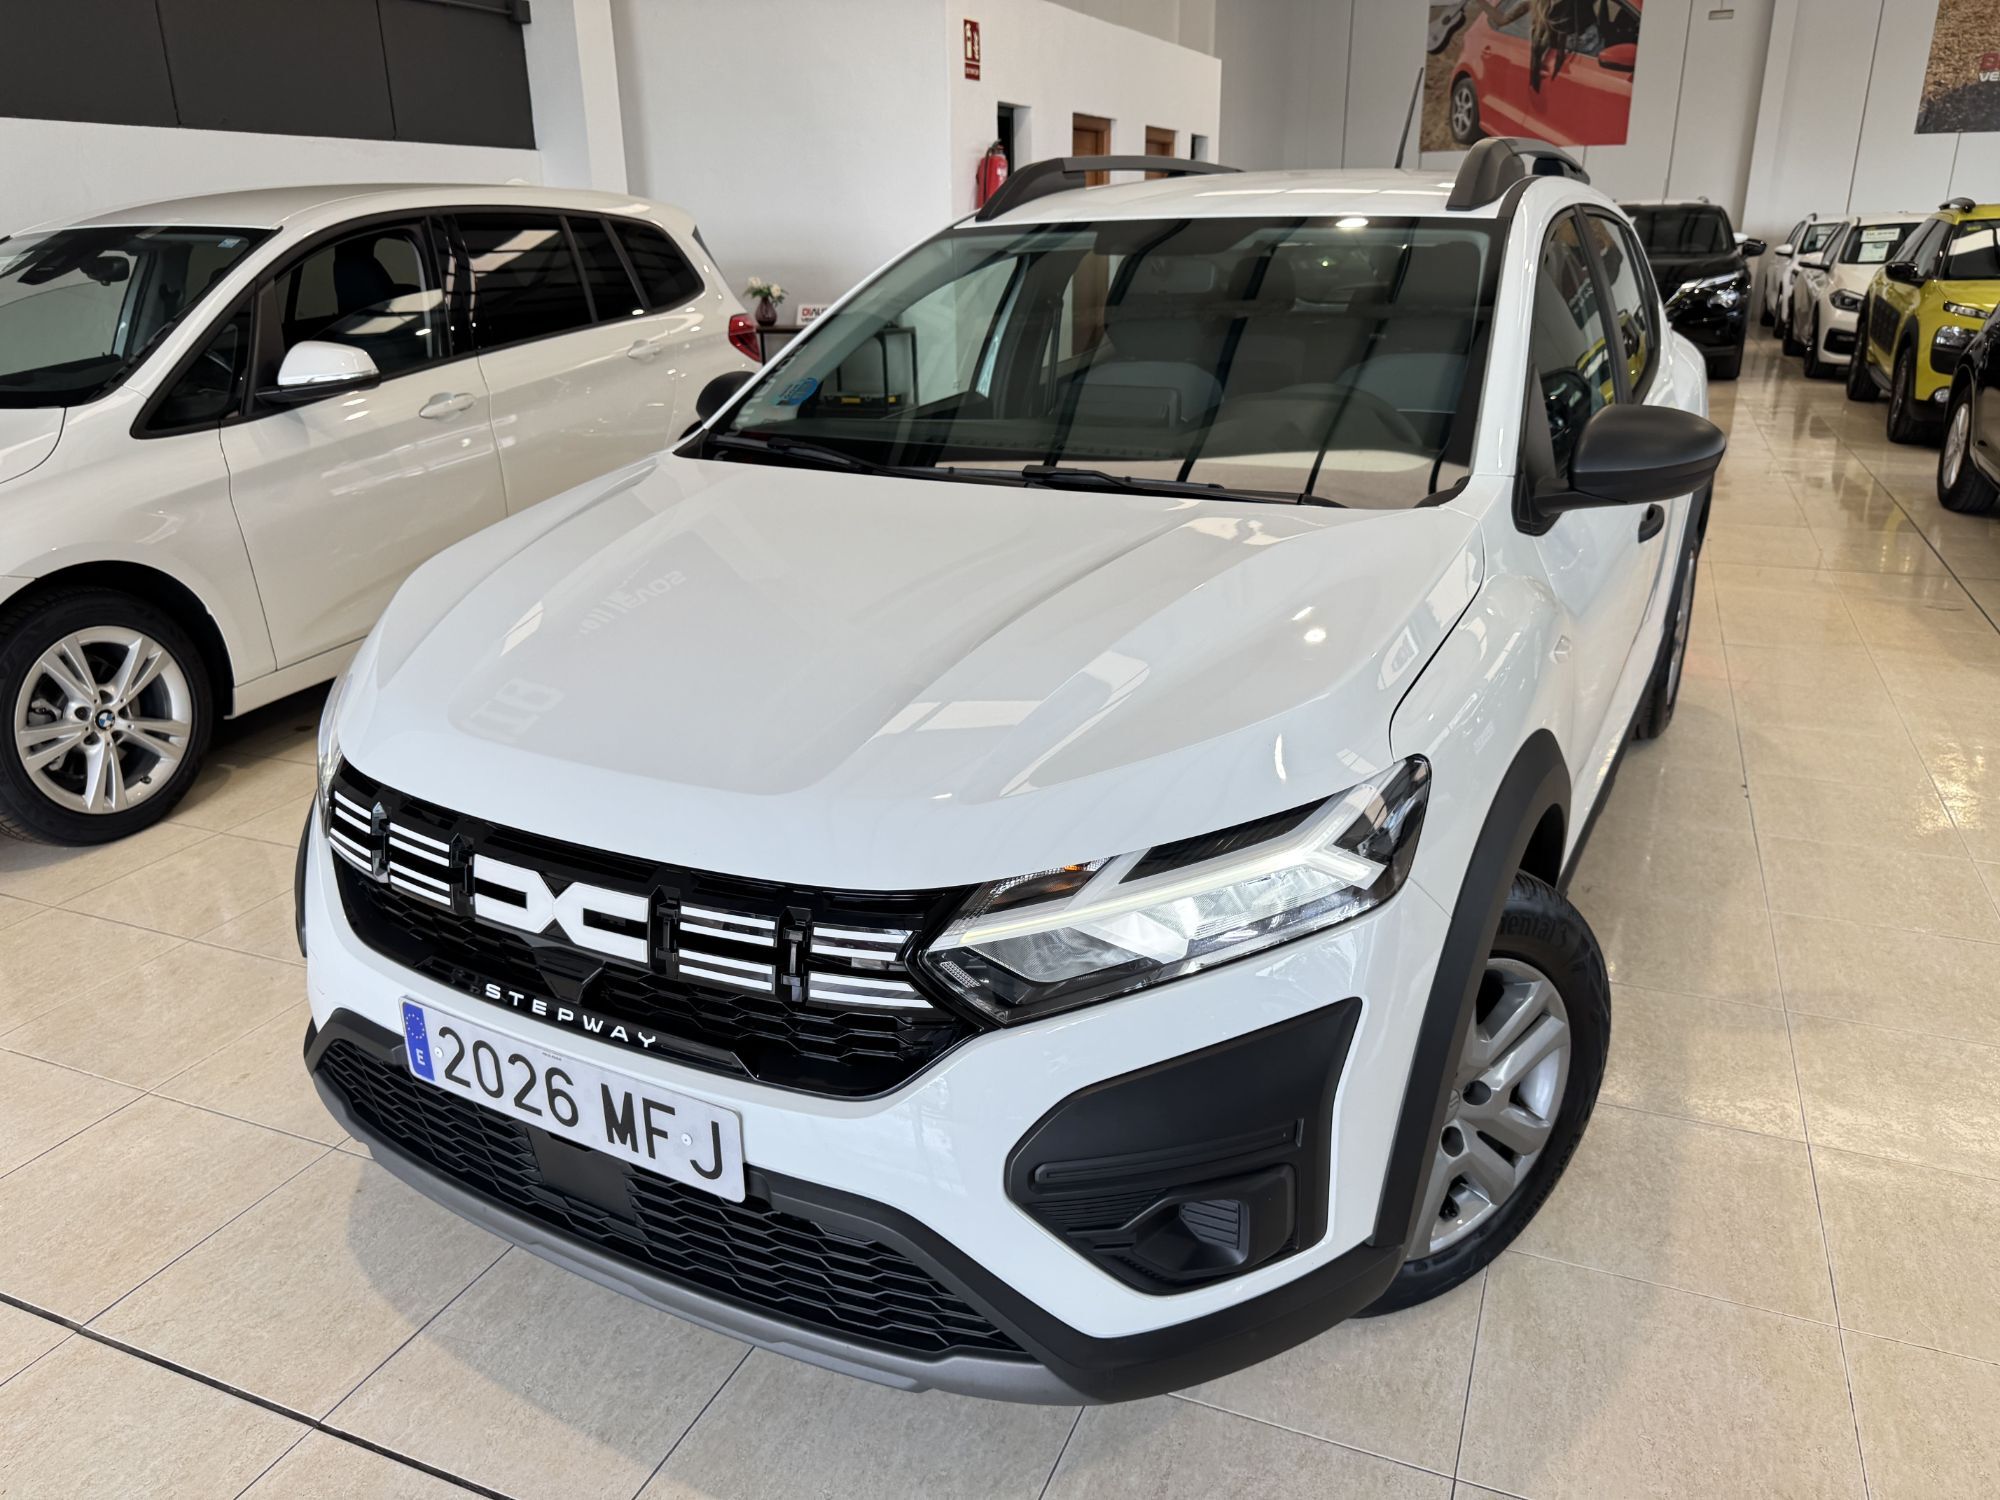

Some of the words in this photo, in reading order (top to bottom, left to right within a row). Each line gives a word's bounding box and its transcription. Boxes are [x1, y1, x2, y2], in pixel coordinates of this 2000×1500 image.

[1980, 71, 2000, 82] VE
[485, 983, 656, 1048] STEPWAY
[416, 1048, 426, 1066] E
[438, 1026, 579, 1128] 2026
